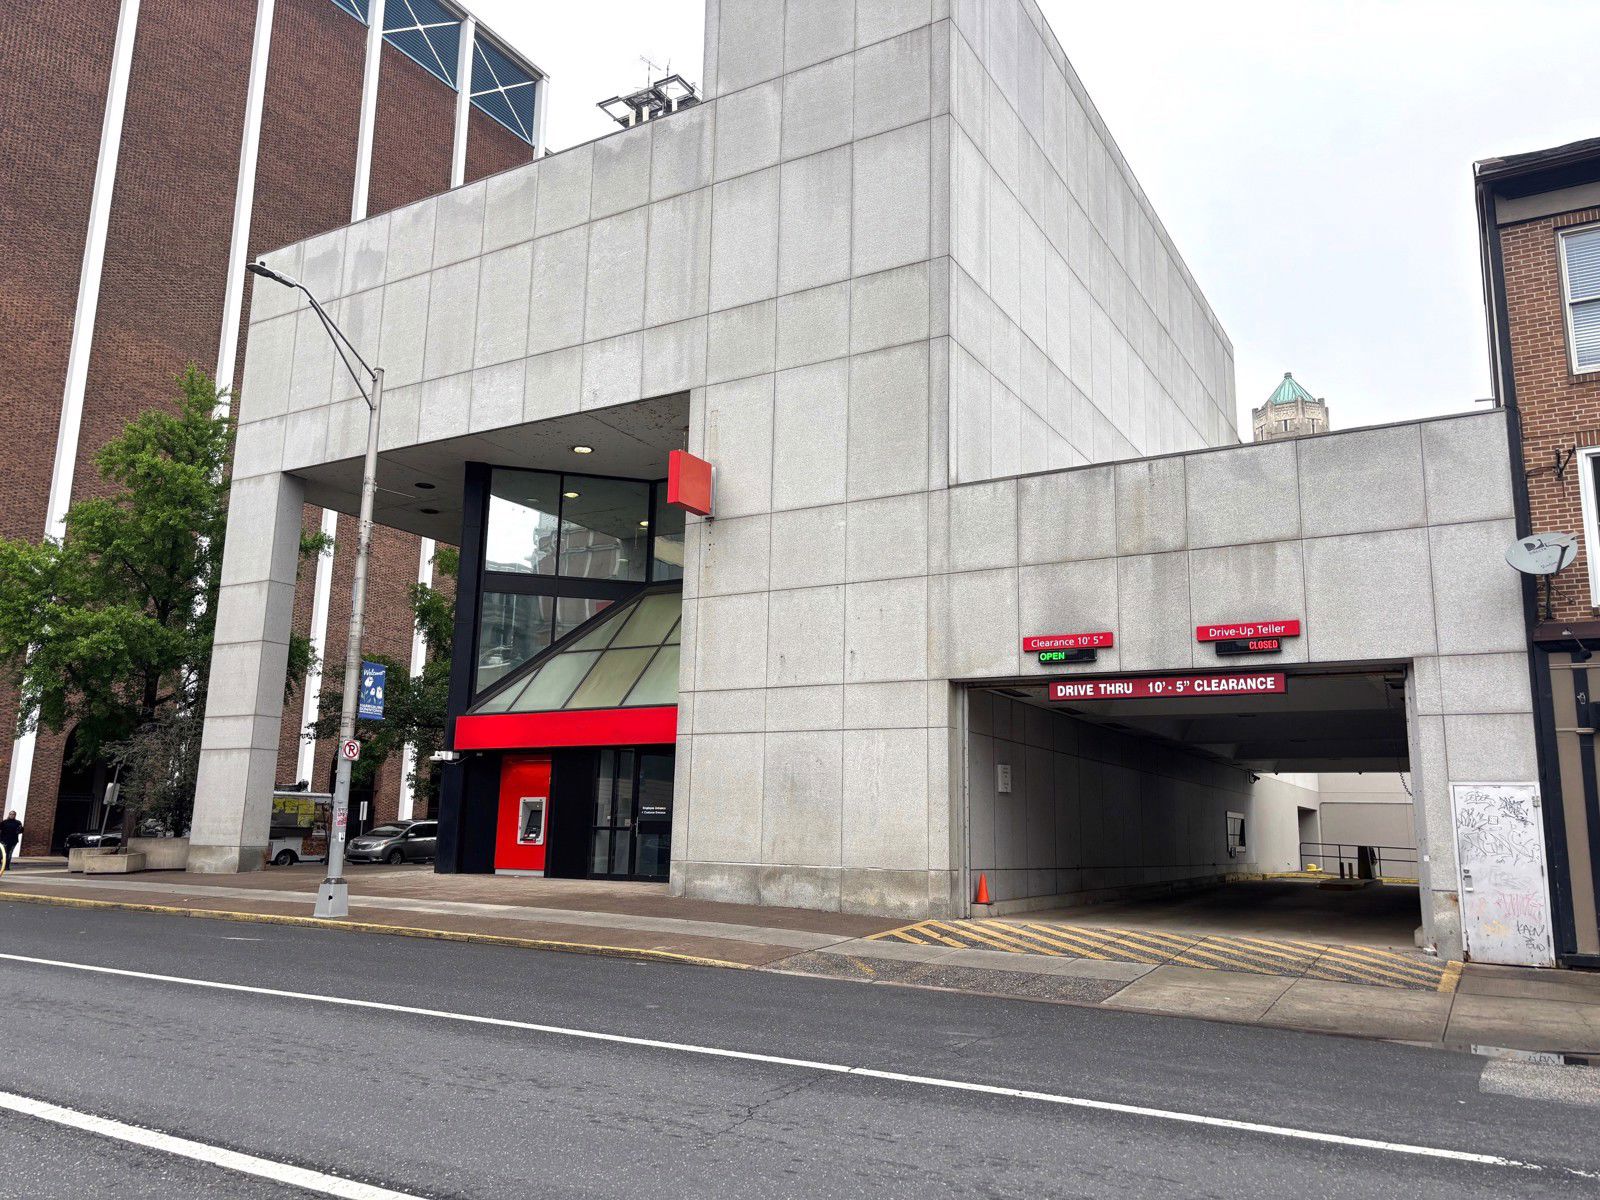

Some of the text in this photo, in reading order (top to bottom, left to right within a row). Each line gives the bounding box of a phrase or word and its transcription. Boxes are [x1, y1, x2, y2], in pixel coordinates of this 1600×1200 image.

[1209, 624, 1285, 637] Drive-Up Teller
[1031, 639, 1075, 648] Clearance
[1077, 637, 1090, 645] 10'
[1249, 640, 1278, 650] CLOSED
[1040, 652, 1065, 661] OPEN
[1057, 684, 1094, 697] DRIVE
[1099, 683, 1133, 695] THRU
[1194, 677, 1275, 691] CLEARANCE
